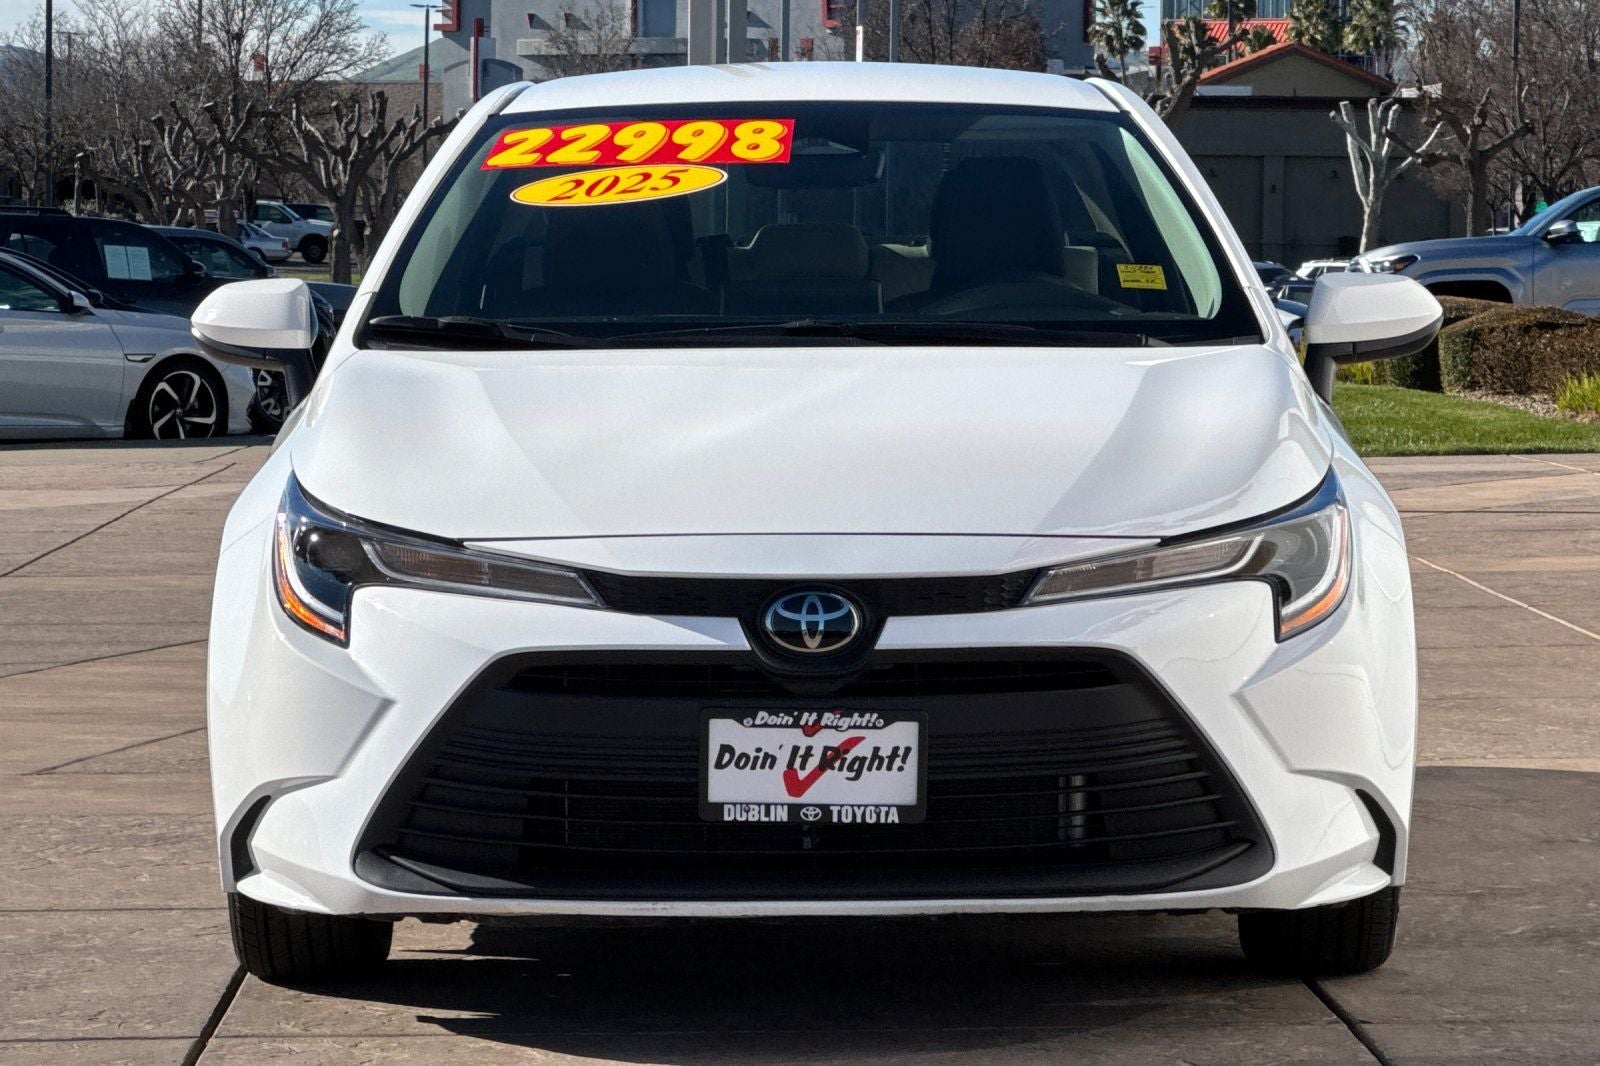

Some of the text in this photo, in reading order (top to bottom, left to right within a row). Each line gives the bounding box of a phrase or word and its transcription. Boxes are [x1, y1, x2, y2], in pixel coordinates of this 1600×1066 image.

[487, 120, 788, 166] 22998
[547, 169, 688, 201] 2025
[754, 711, 878, 731] Doin' It Right!
[714, 743, 912, 781] Doin' It Right!
[723, 804, 899, 823] DUBLIN TOYOTA
